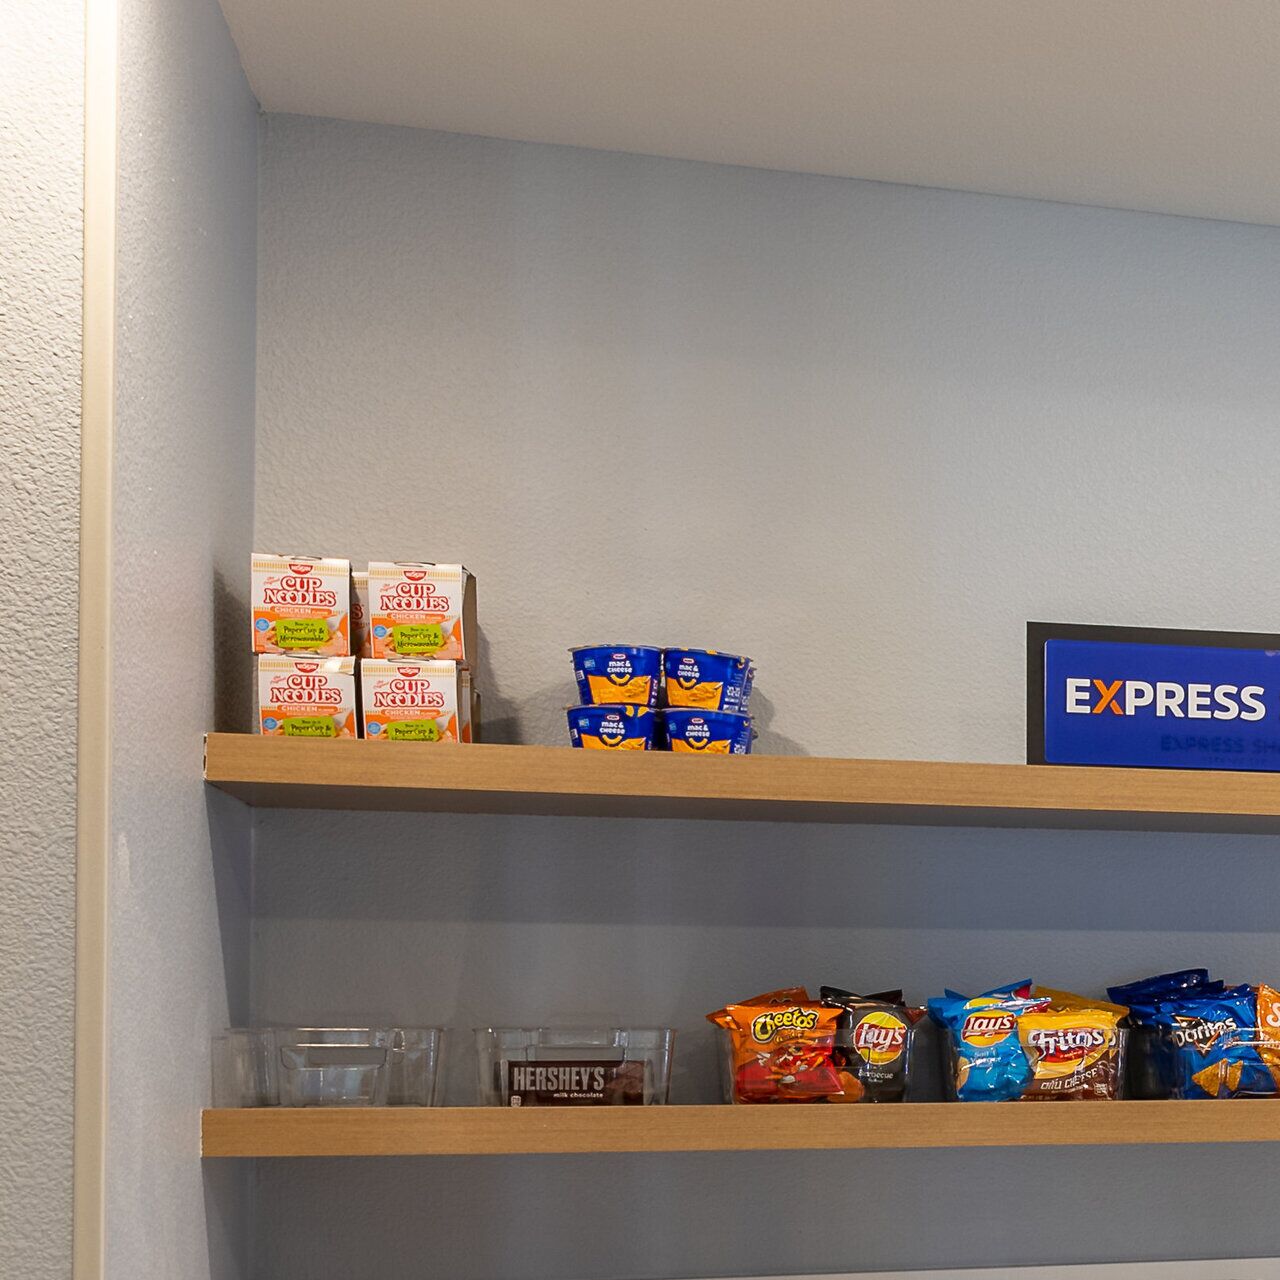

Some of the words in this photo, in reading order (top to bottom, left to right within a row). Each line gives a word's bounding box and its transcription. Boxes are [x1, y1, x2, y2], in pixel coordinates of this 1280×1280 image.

[280, 575, 323, 592] CUP
[395, 582, 436, 597] CUP
[263, 588, 337, 607] NOODLES
[380, 595, 450, 612] NOODLES
[286, 674, 328, 690] CUP
[389, 679, 430, 694] CUP
[270, 687, 342, 704] NOODLES
[373, 692, 444, 707] NOODLES
[1065, 676, 1267, 722] EXPRESS
[753, 1009, 818, 1042] Cheetos
[964, 1015, 1015, 1038] Lay's
[1174, 1017, 1237, 1047] Doritos
[858, 1022, 908, 1052] Lay's
[513, 1066, 605, 1091] HERSHEY'S
